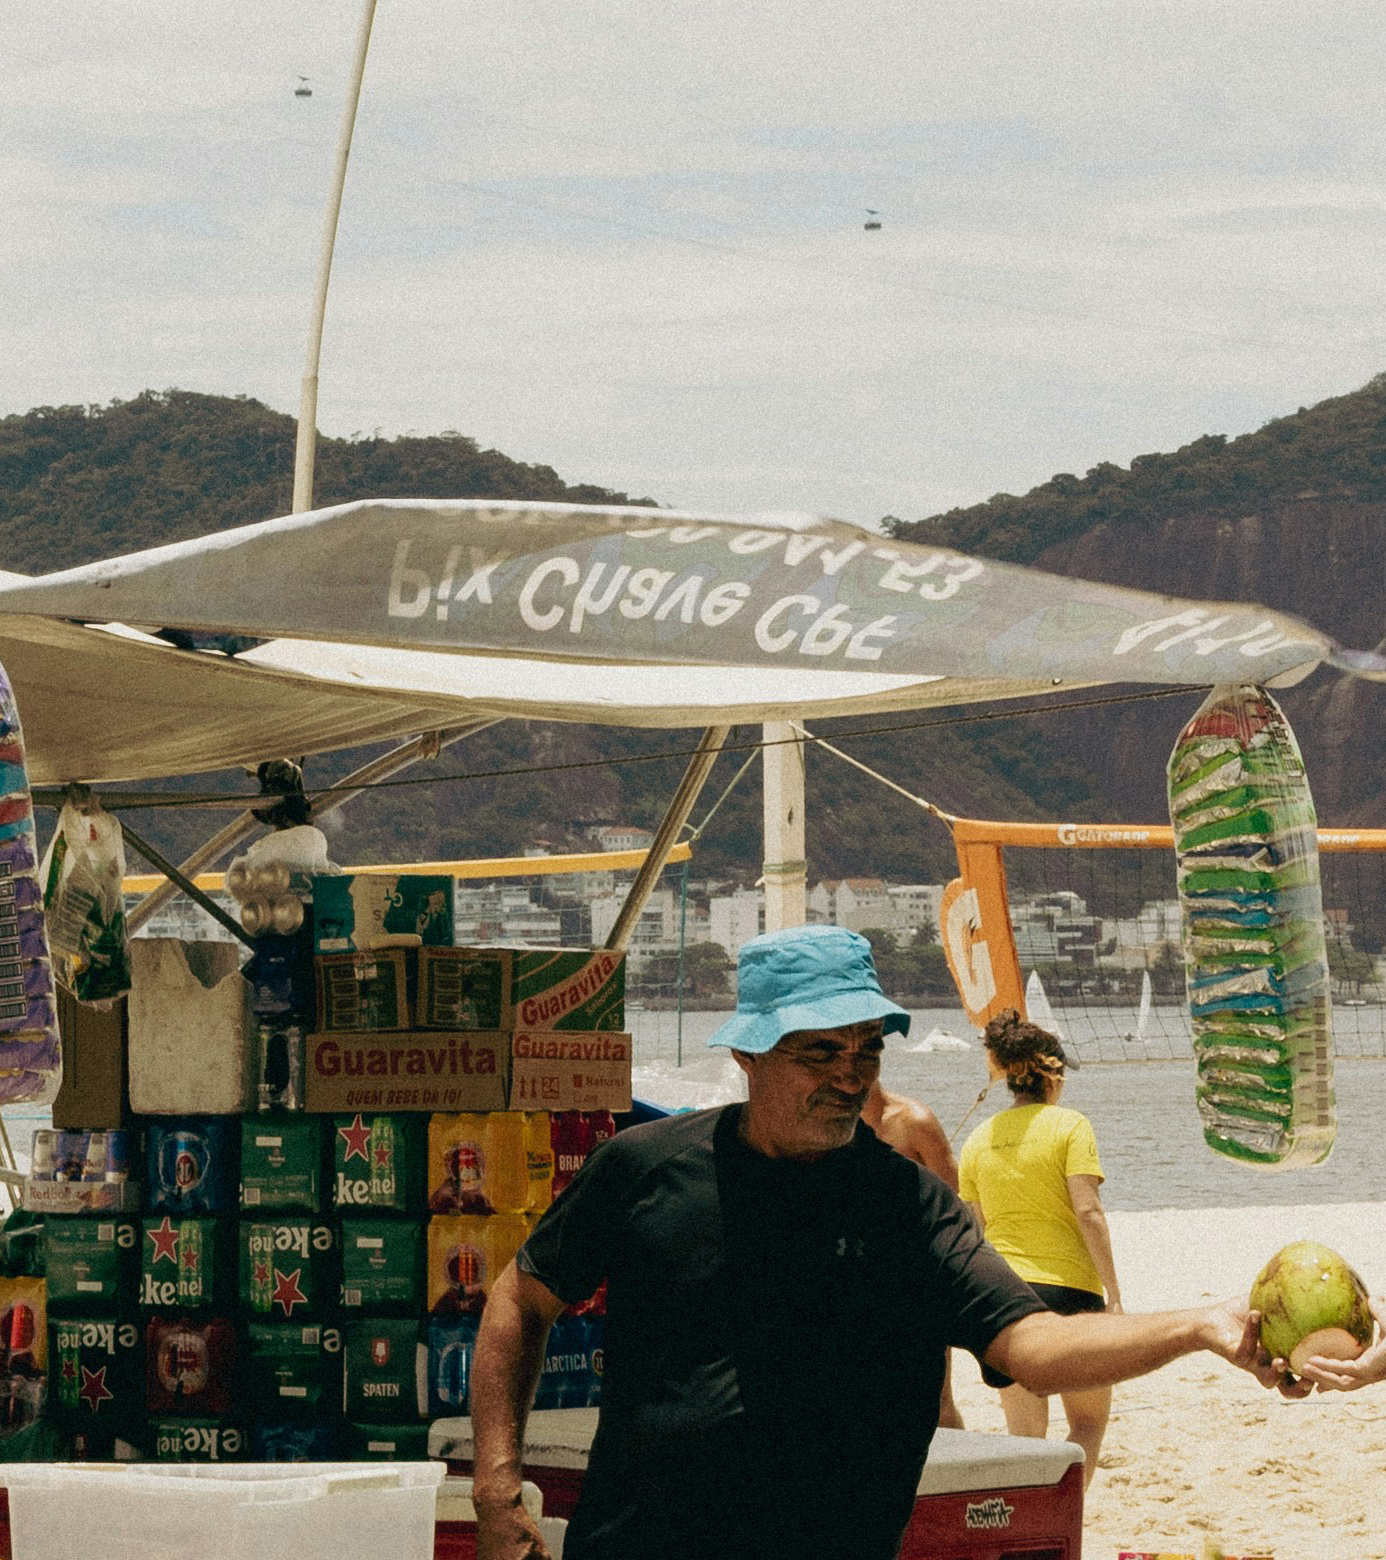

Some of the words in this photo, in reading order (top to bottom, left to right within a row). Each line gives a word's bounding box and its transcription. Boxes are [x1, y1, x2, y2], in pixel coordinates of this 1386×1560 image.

[521, 954, 613, 1026] Guaravita
[315, 1040, 497, 1077] Guaravita
[514, 1035, 626, 1061] Guaravita
[559, 1154, 586, 1172] BRA
[542, 1353, 588, 1374] ARCTICA
[363, 1383, 400, 1397] SPATEN
